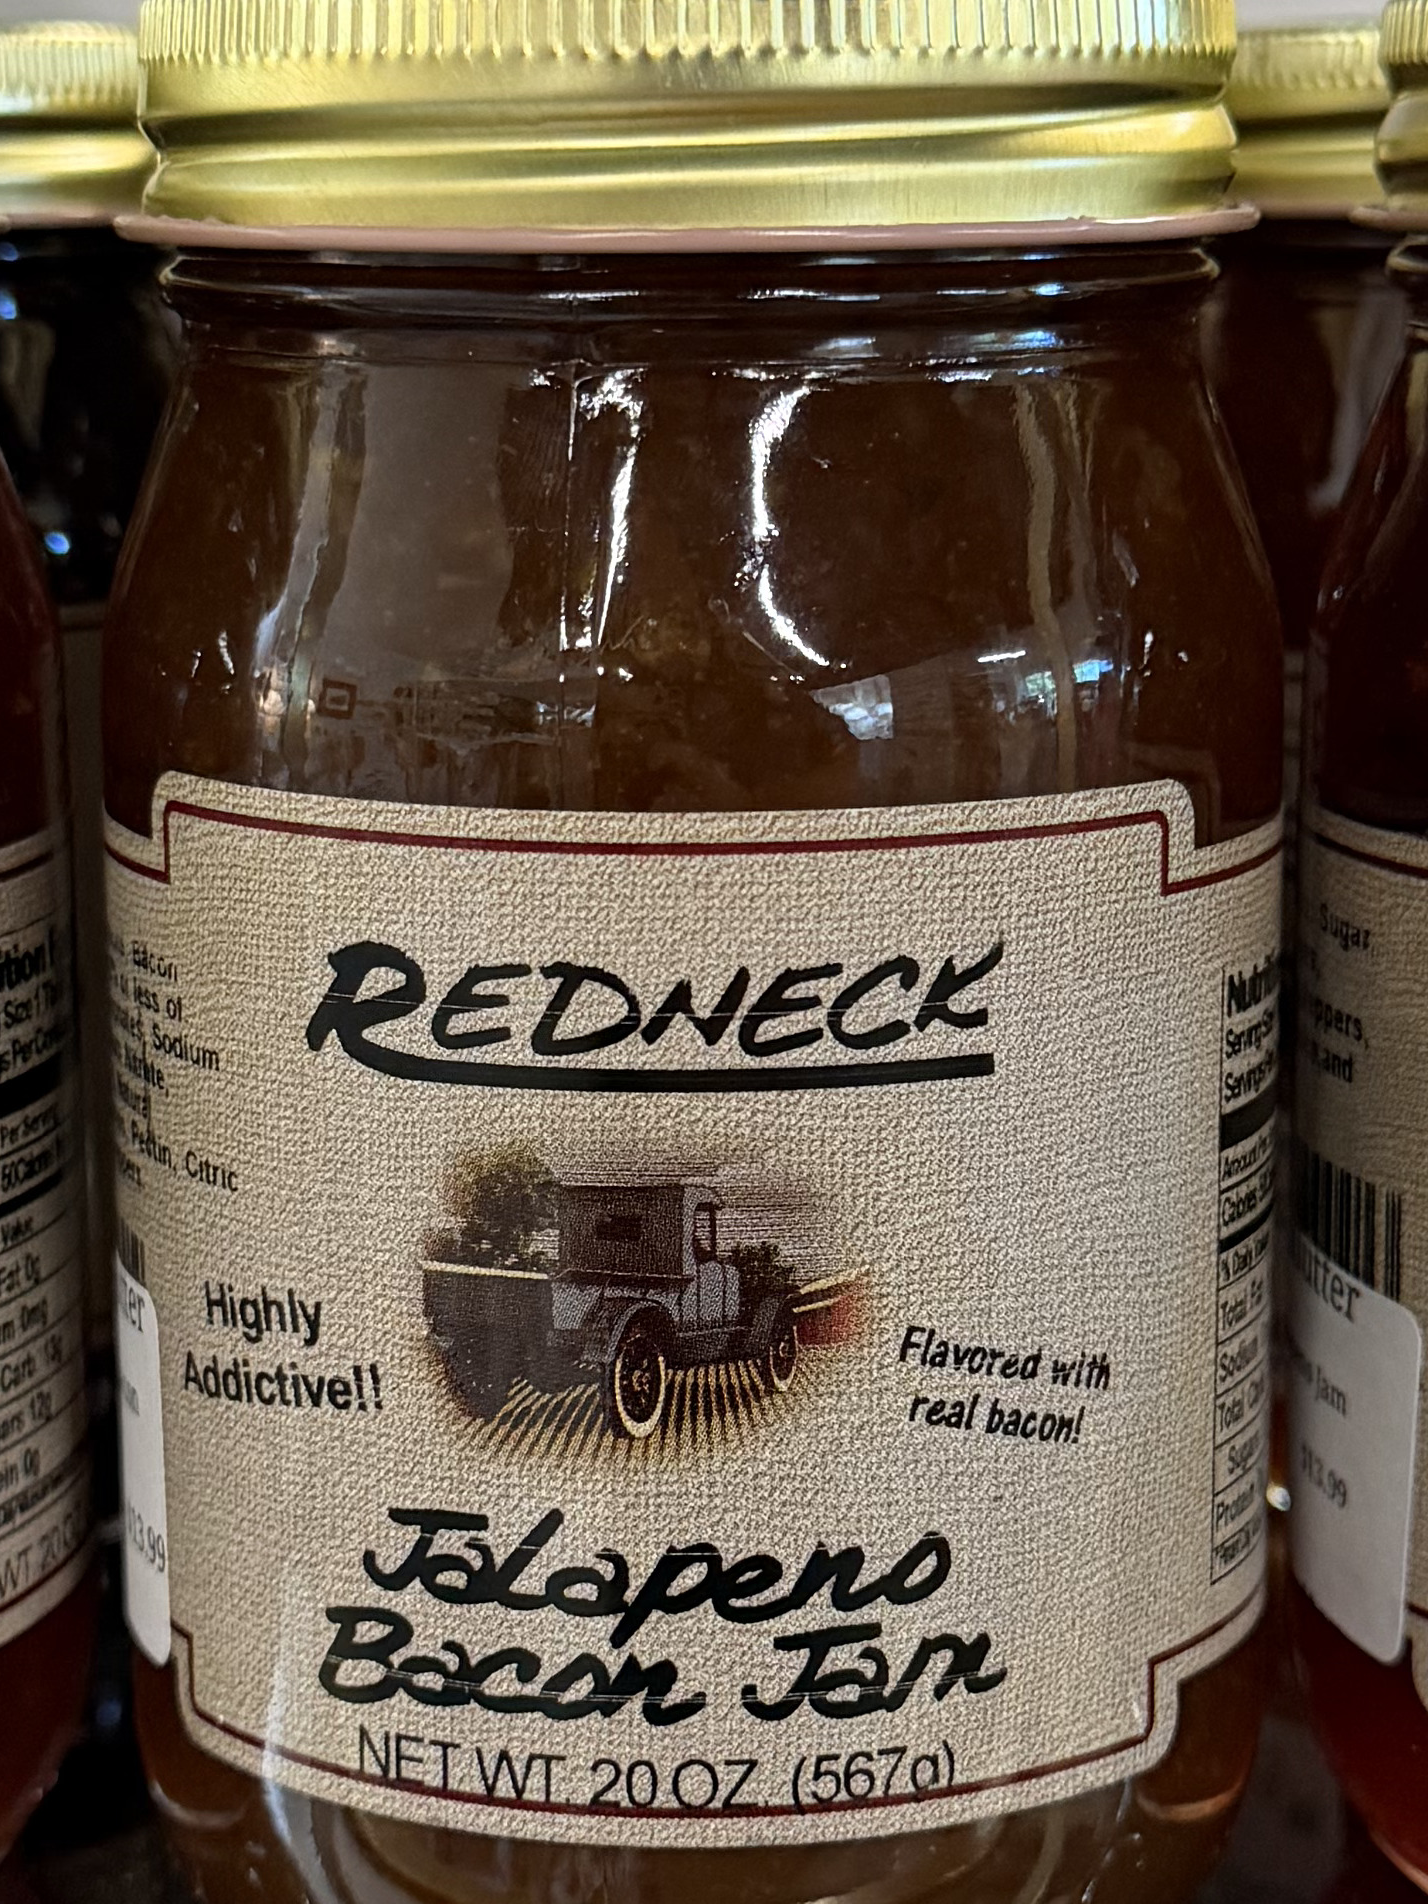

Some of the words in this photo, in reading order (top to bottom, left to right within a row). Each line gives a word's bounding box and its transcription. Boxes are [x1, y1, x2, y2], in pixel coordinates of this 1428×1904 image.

[152, 1022, 221, 1072] Sodium
[305, 940, 1004, 1093] REDNECK
[184, 1149, 239, 1192] Citric
[205, 1280, 323, 1344] Highly
[183, 1349, 384, 1412] Addictive!!
[899, 1324, 1040, 1383] Flavored
[1051, 1349, 1113, 1390] with
[908, 1392, 975, 1431] real
[984, 1398, 1084, 1446] bacon!
[363, 1508, 952, 1649] Jalapeno
[318, 1606, 706, 1726] Bacon
[742, 1622, 1008, 1723] Jam
[358, 1724, 461, 1788] NET
[590, 1758, 658, 1809] 20
[790, 1741, 957, 1814] (567g)
